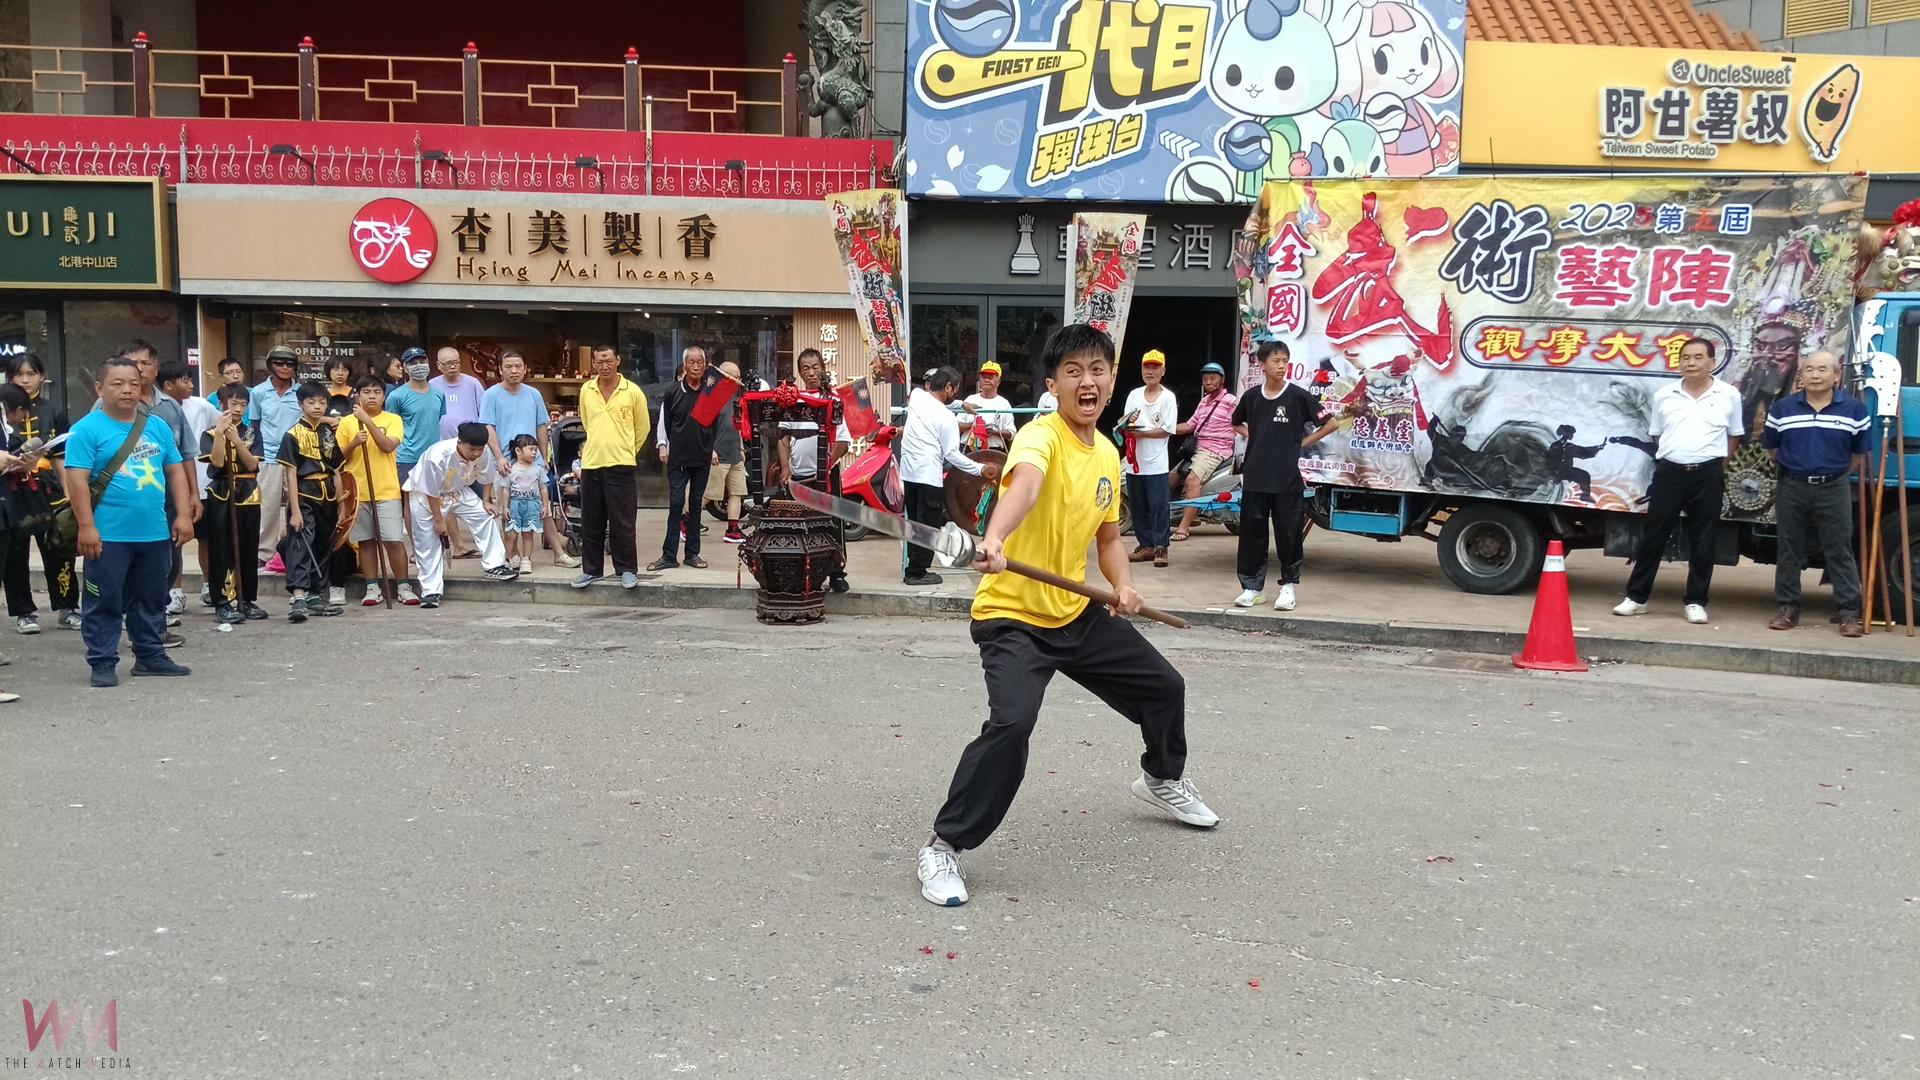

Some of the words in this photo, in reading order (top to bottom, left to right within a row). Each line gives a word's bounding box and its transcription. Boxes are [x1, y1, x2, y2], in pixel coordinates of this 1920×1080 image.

[981, 57, 1034, 79] FIRST
[1036, 55, 1062, 70] GEN
[1694, 63, 1792, 84] UncleSweet
[1605, 88, 1789, 140] 阿甘薯叔
[1031, 114, 1143, 182] 彈珠台
[1604, 141, 1642, 154] Taiwan
[1645, 142, 1679, 155] Sweet
[1681, 143, 1716, 157] Potato
[59, 255, 118, 268] 北港中山店
[456, 256, 530, 282] Hsing
[550, 259, 597, 282] Mei
[617, 260, 715, 286] Incense
[1267, 222, 1317, 340] 全國
[1555, 245, 1734, 308] 藝陣
[295, 347, 324, 356] OPEN
[327, 347, 355, 357] TIME
[1352, 416, 1413, 441] 德義堂
